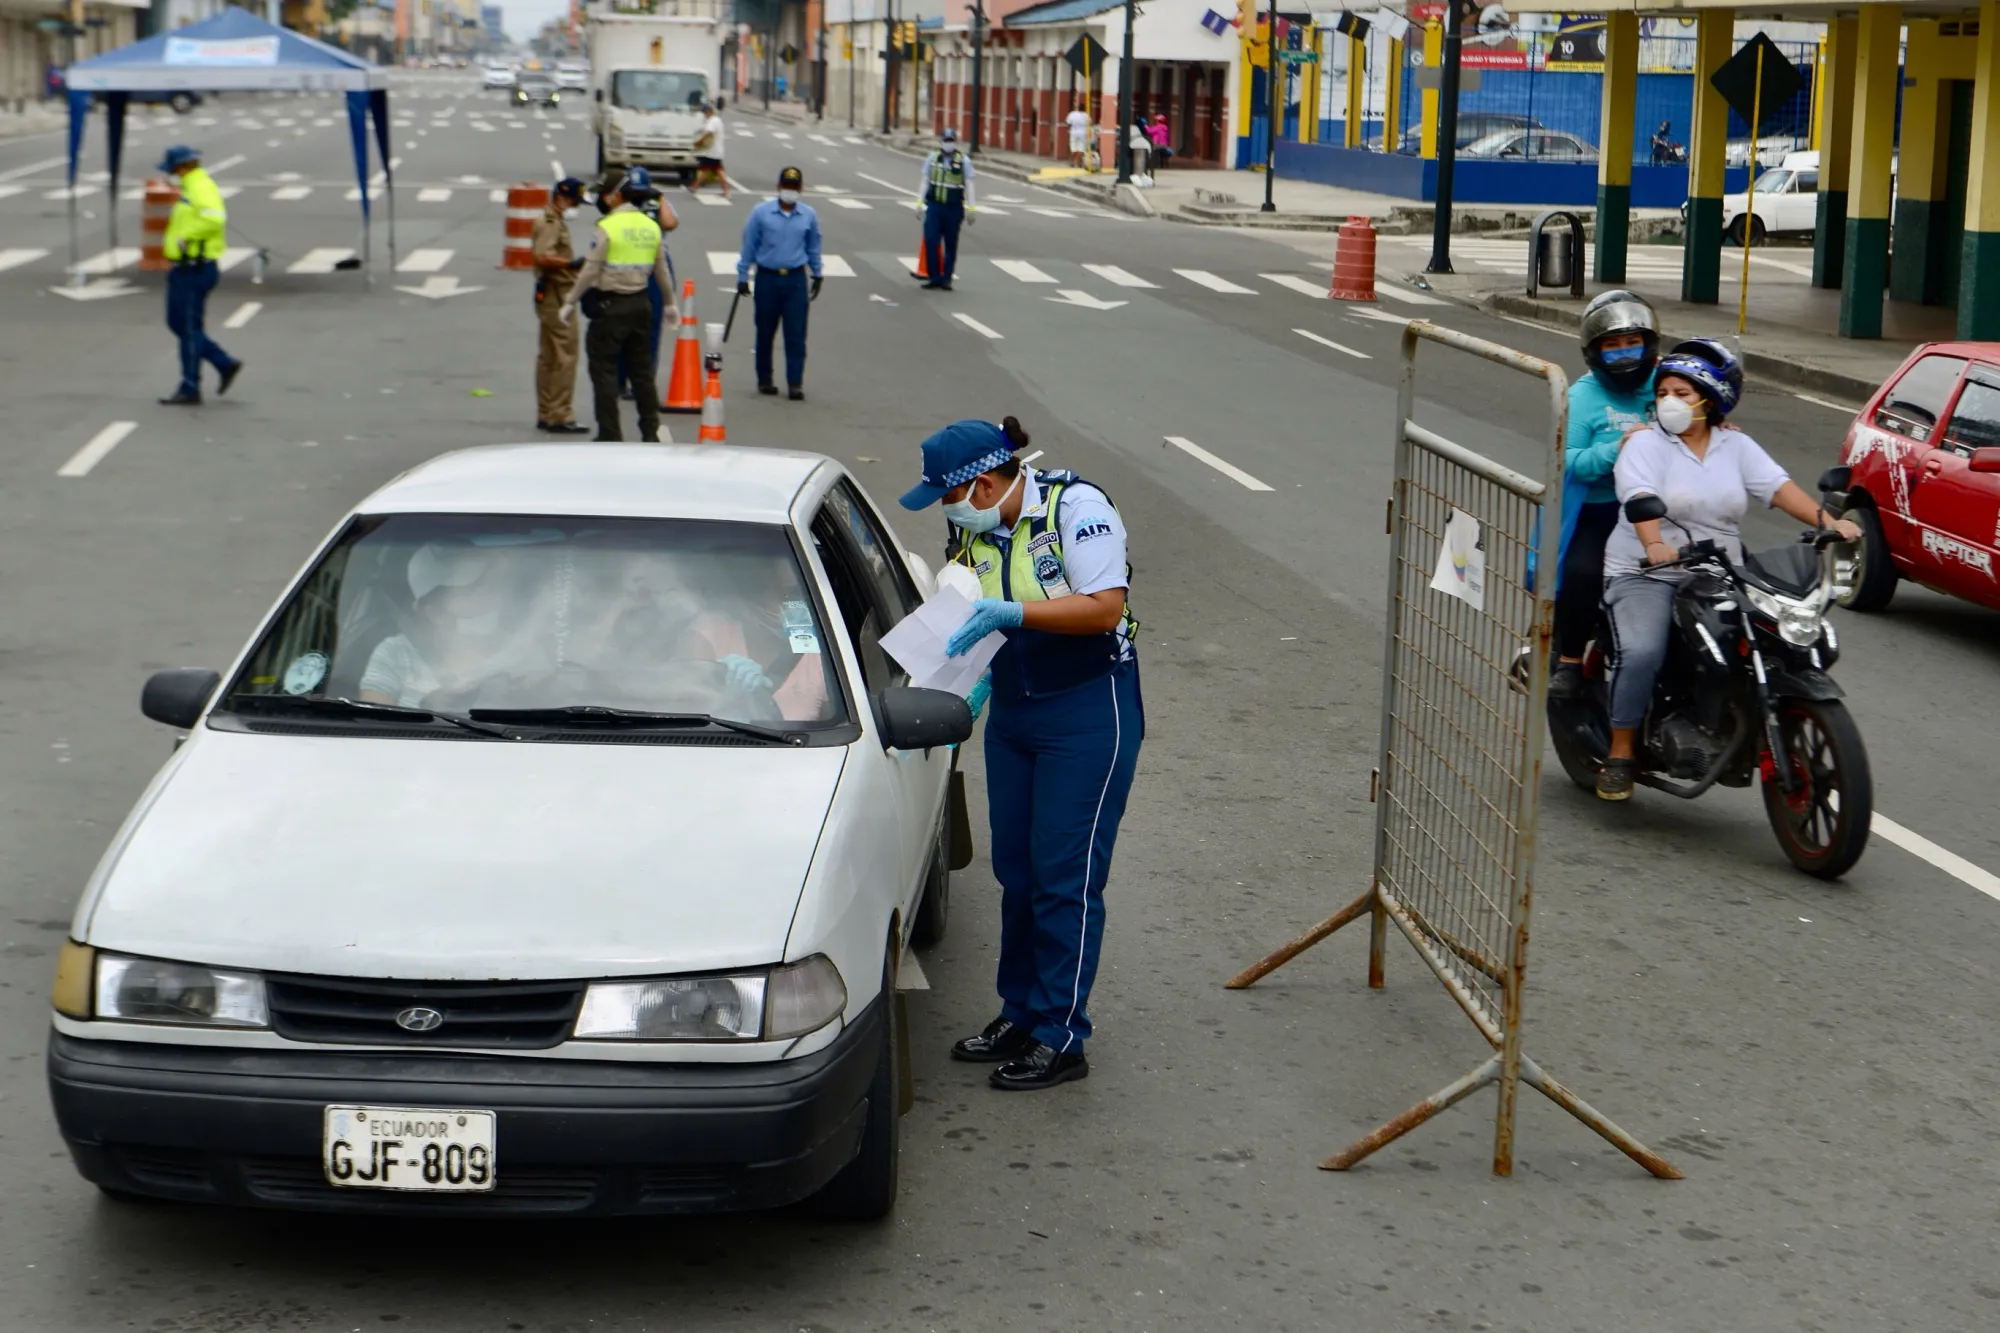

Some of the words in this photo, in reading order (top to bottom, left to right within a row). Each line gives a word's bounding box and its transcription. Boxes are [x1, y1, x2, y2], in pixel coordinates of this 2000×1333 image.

[1560, 40, 1575, 55] 10
[1028, 533, 1056, 552] TRANSITO
[1922, 528, 1997, 584] RAPTOR
[370, 1119, 449, 1138] ECUADOR
[331, 1139, 490, 1185] GJF-809
